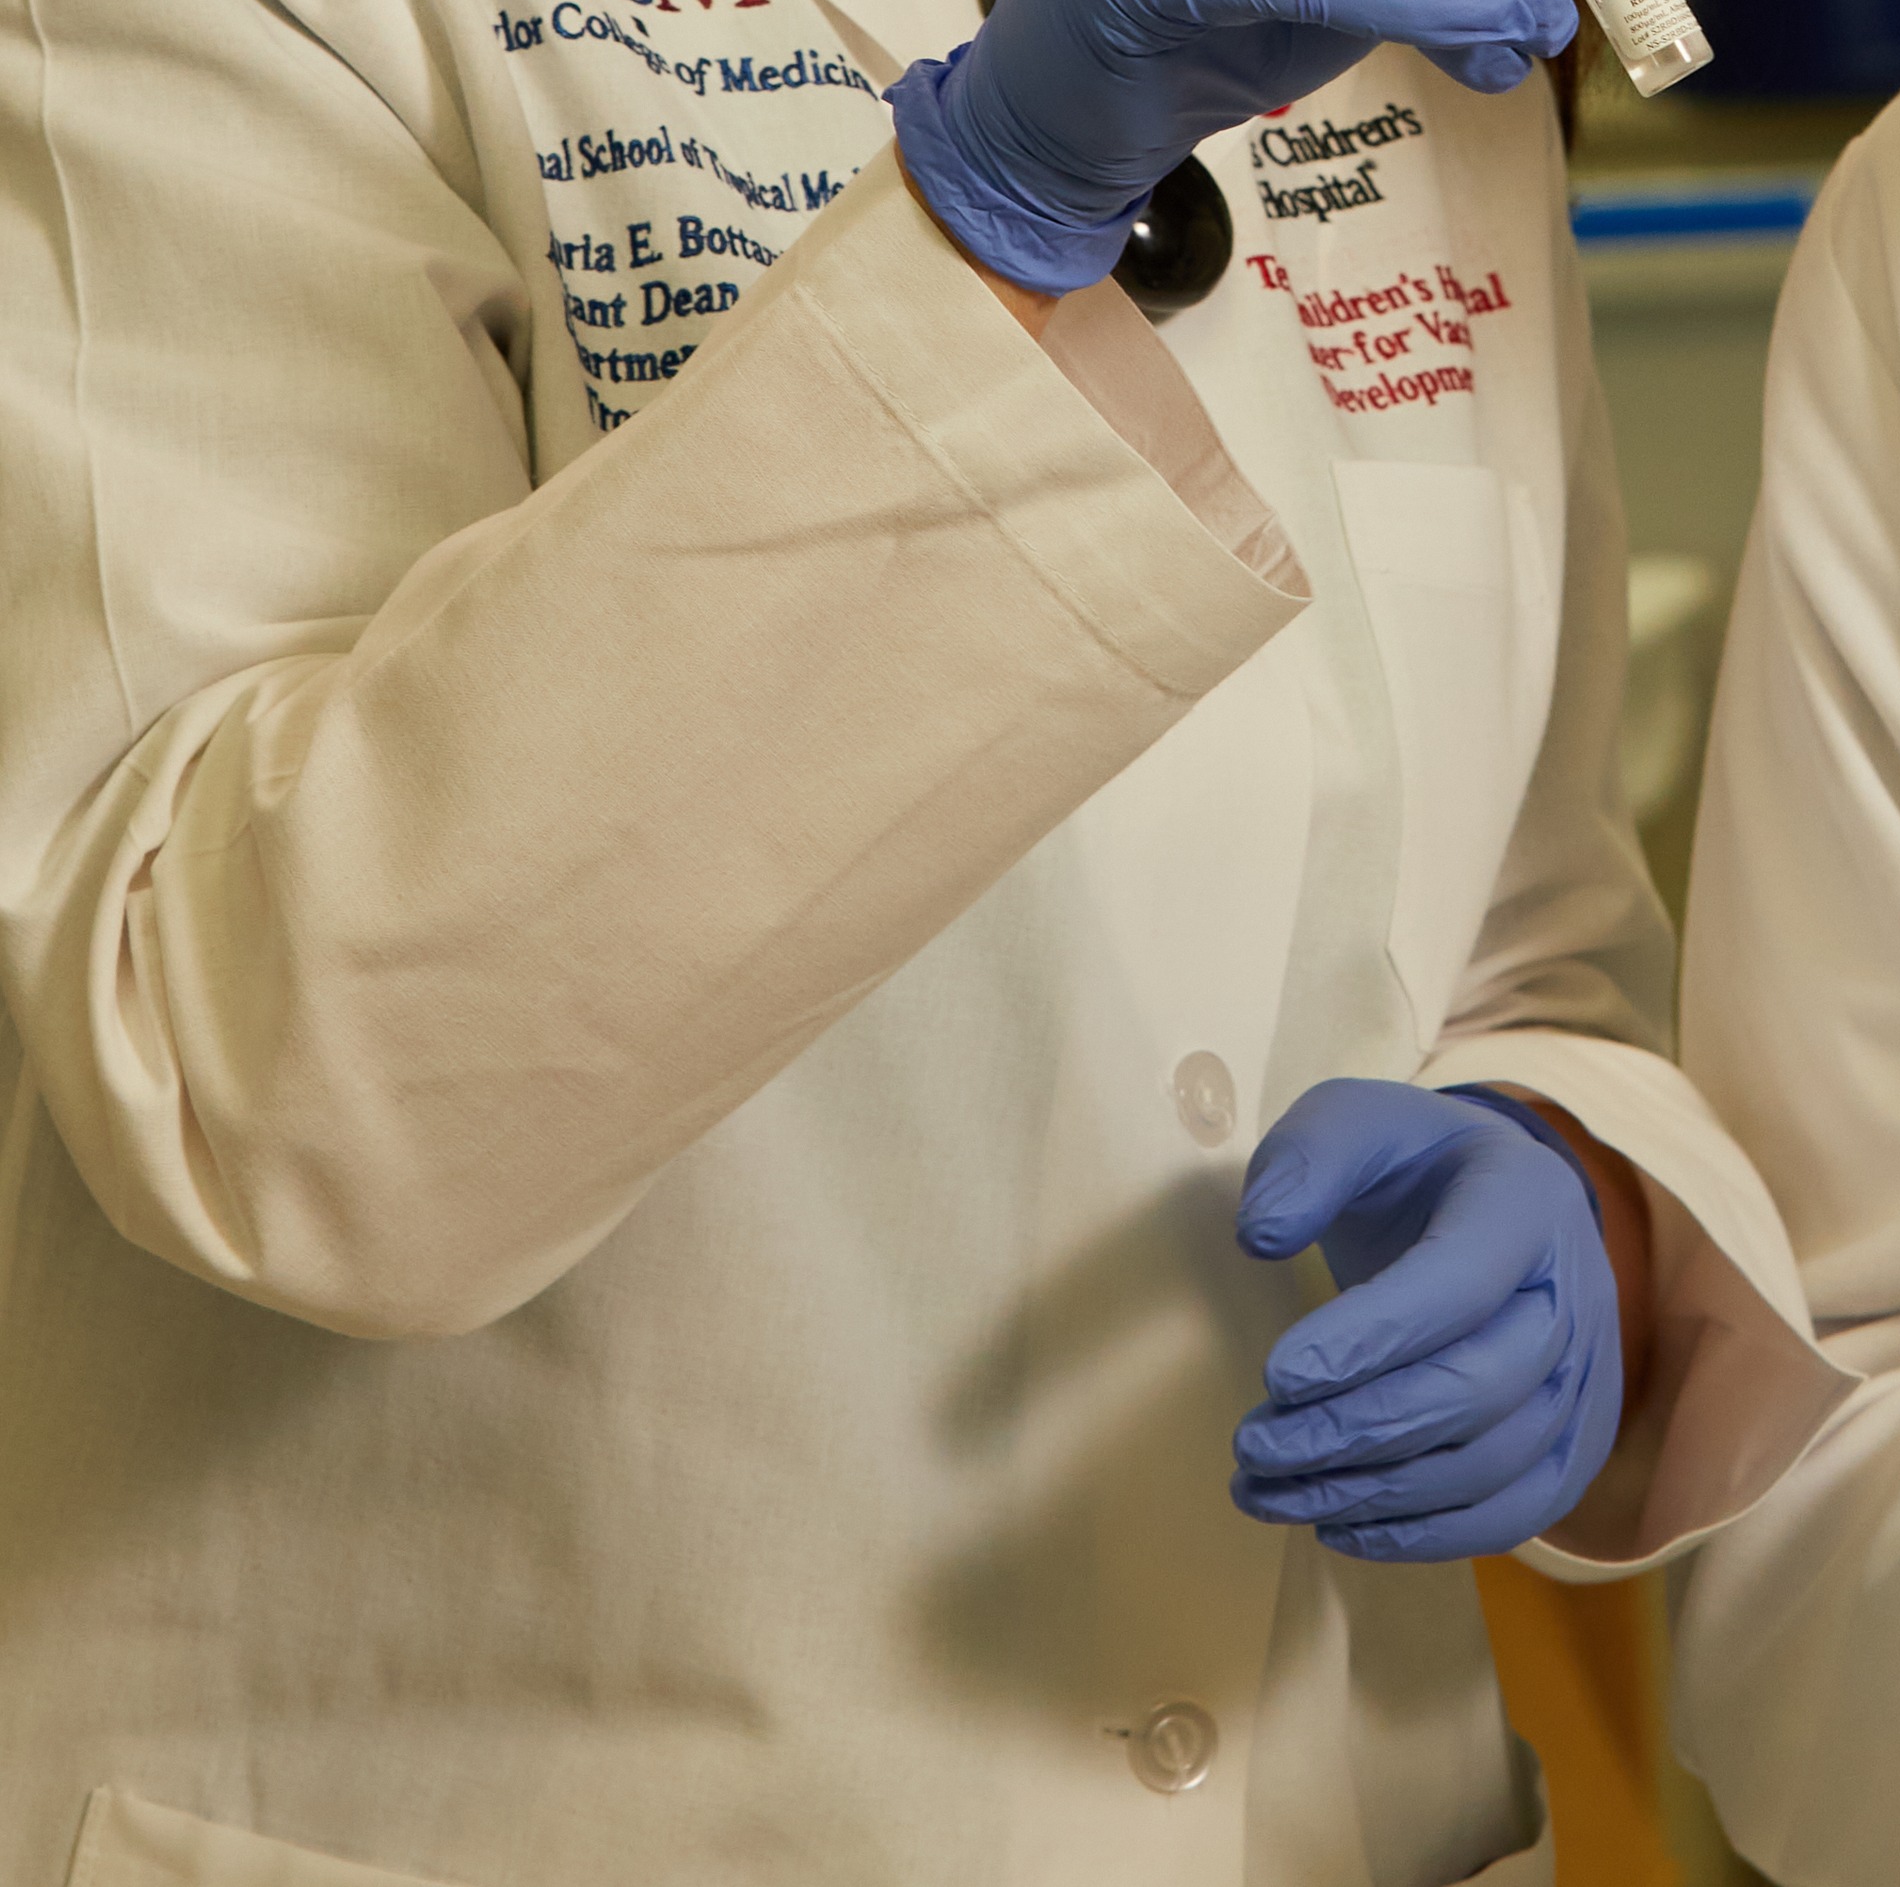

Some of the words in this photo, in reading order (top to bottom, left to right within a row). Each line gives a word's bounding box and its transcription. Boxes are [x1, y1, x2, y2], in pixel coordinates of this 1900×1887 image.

[674, 57, 711, 96] of
[719, 49, 879, 102] Medicin
[578, 125, 676, 180] School
[1260, 102, 1424, 167] Children's
[1352, 329, 1414, 365] for
